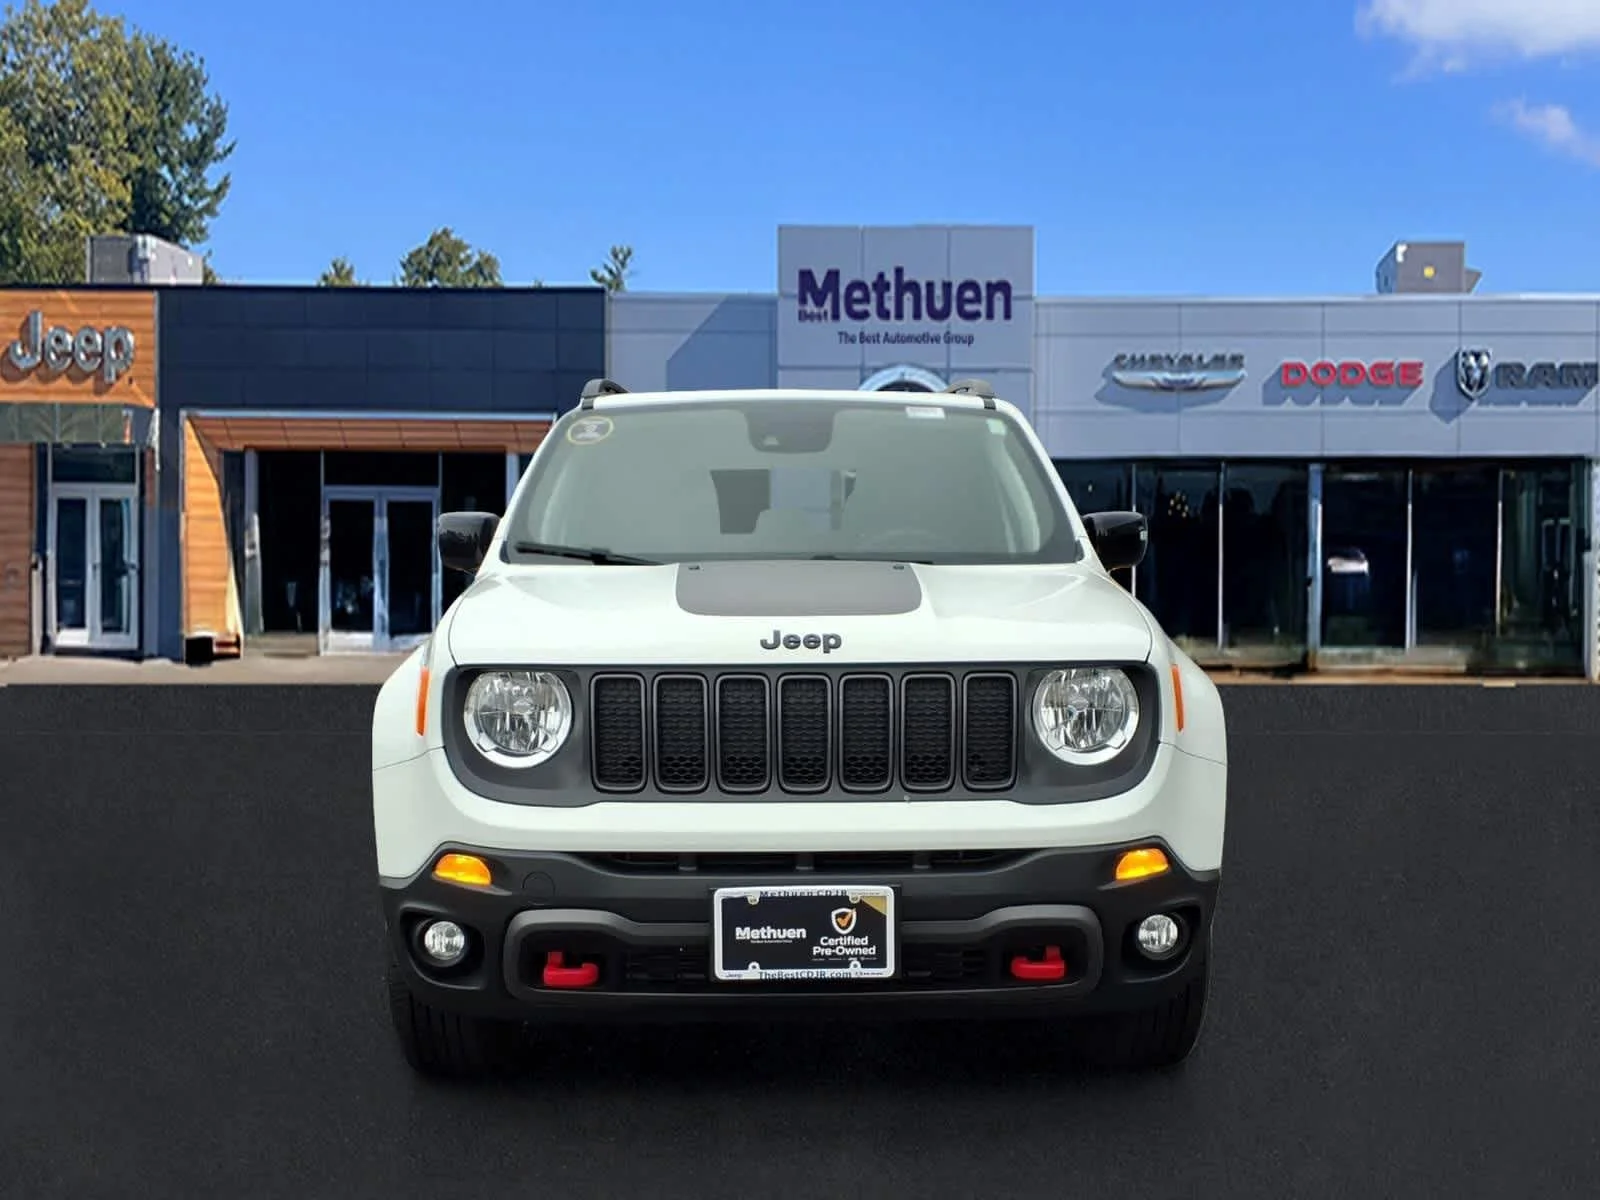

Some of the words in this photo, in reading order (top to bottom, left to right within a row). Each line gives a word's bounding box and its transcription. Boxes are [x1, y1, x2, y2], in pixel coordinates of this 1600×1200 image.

[798, 266, 1012, 322] Methuen
[8, 310, 135, 384] Jeep
[838, 331, 857, 344] The
[859, 331, 881, 344] Best
[883, 331, 941, 344] Automotive
[943, 331, 974, 347] Group
[1113, 353, 1245, 369] CHRYSLER
[1281, 361, 1424, 387] DODGE
[1495, 362, 1599, 388] RAM
[760, 629, 842, 654] Jeep
[735, 926, 807, 939] Methuen
[820, 936, 869, 946] Certified
[812, 945, 876, 956] Pre-Owned
[759, 970, 852, 979] TheBestCDJR.com
